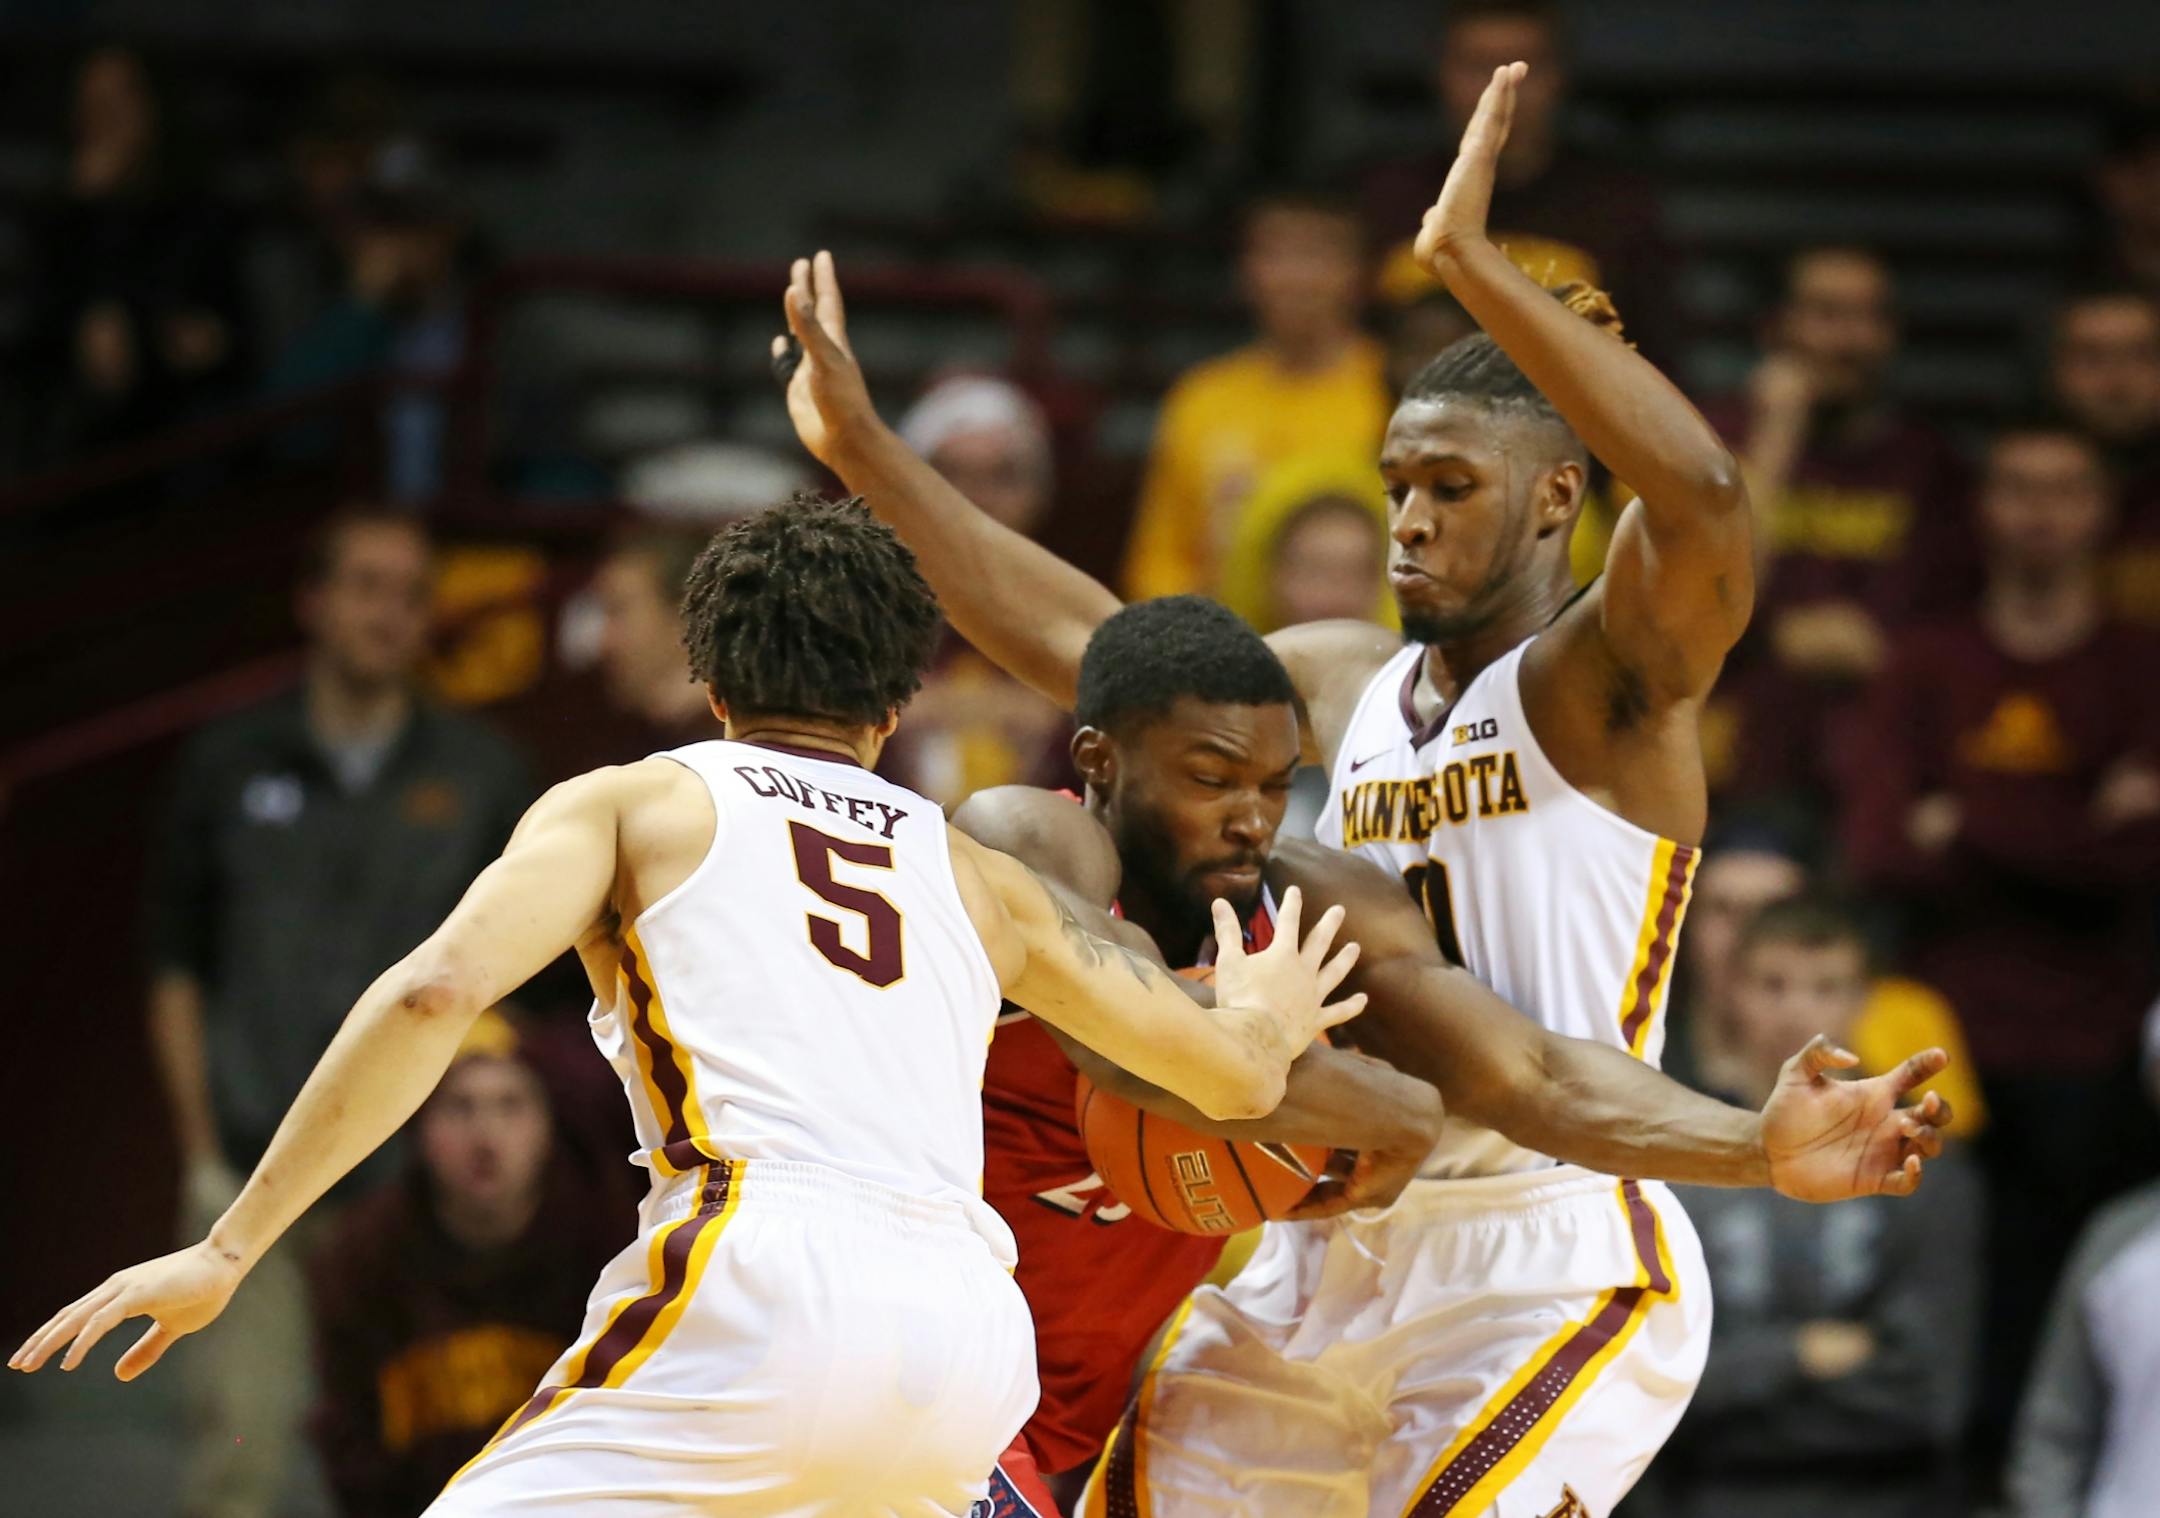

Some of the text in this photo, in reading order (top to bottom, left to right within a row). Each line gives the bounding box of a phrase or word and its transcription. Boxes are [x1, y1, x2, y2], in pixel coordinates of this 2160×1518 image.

[1452, 718, 1498, 747] B1G
[734, 766, 908, 839] COFFEY
[787, 818, 905, 990] 5
[1173, 1150, 1236, 1231] ELITE
